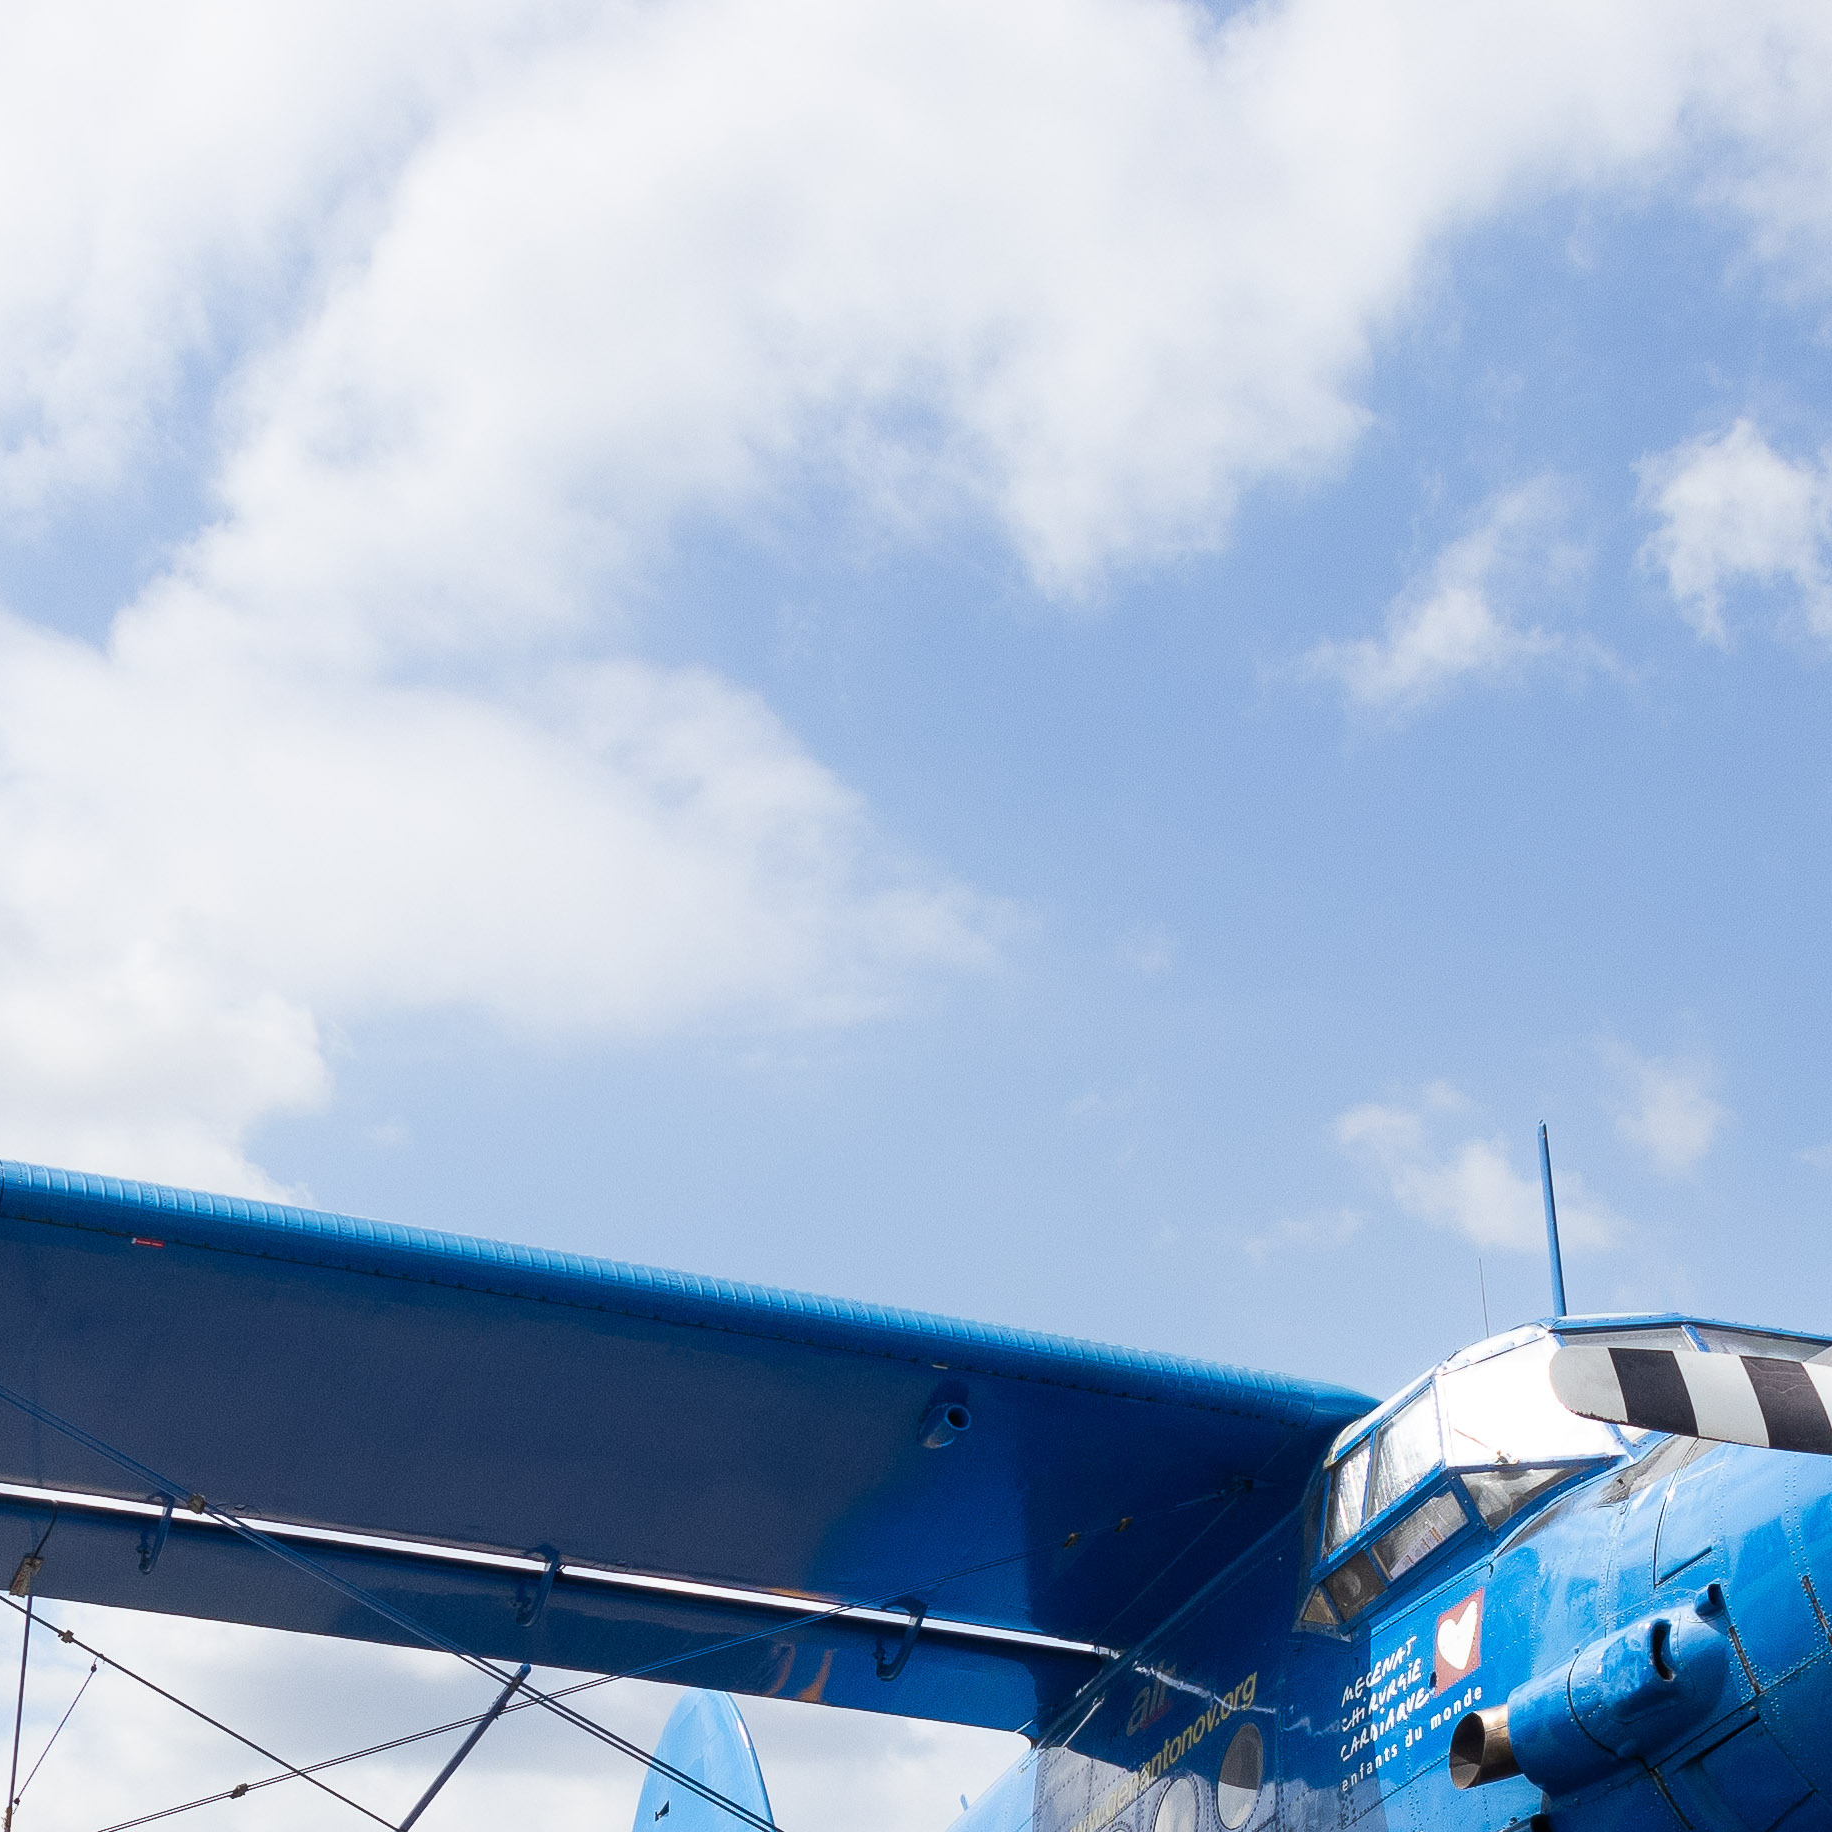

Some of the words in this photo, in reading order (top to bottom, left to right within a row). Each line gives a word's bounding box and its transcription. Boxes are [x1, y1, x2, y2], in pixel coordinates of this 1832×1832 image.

[1341, 1744, 1398, 1792] enfants
[1405, 1726, 1423, 1748] du
[1430, 1686, 1482, 1731] monde
